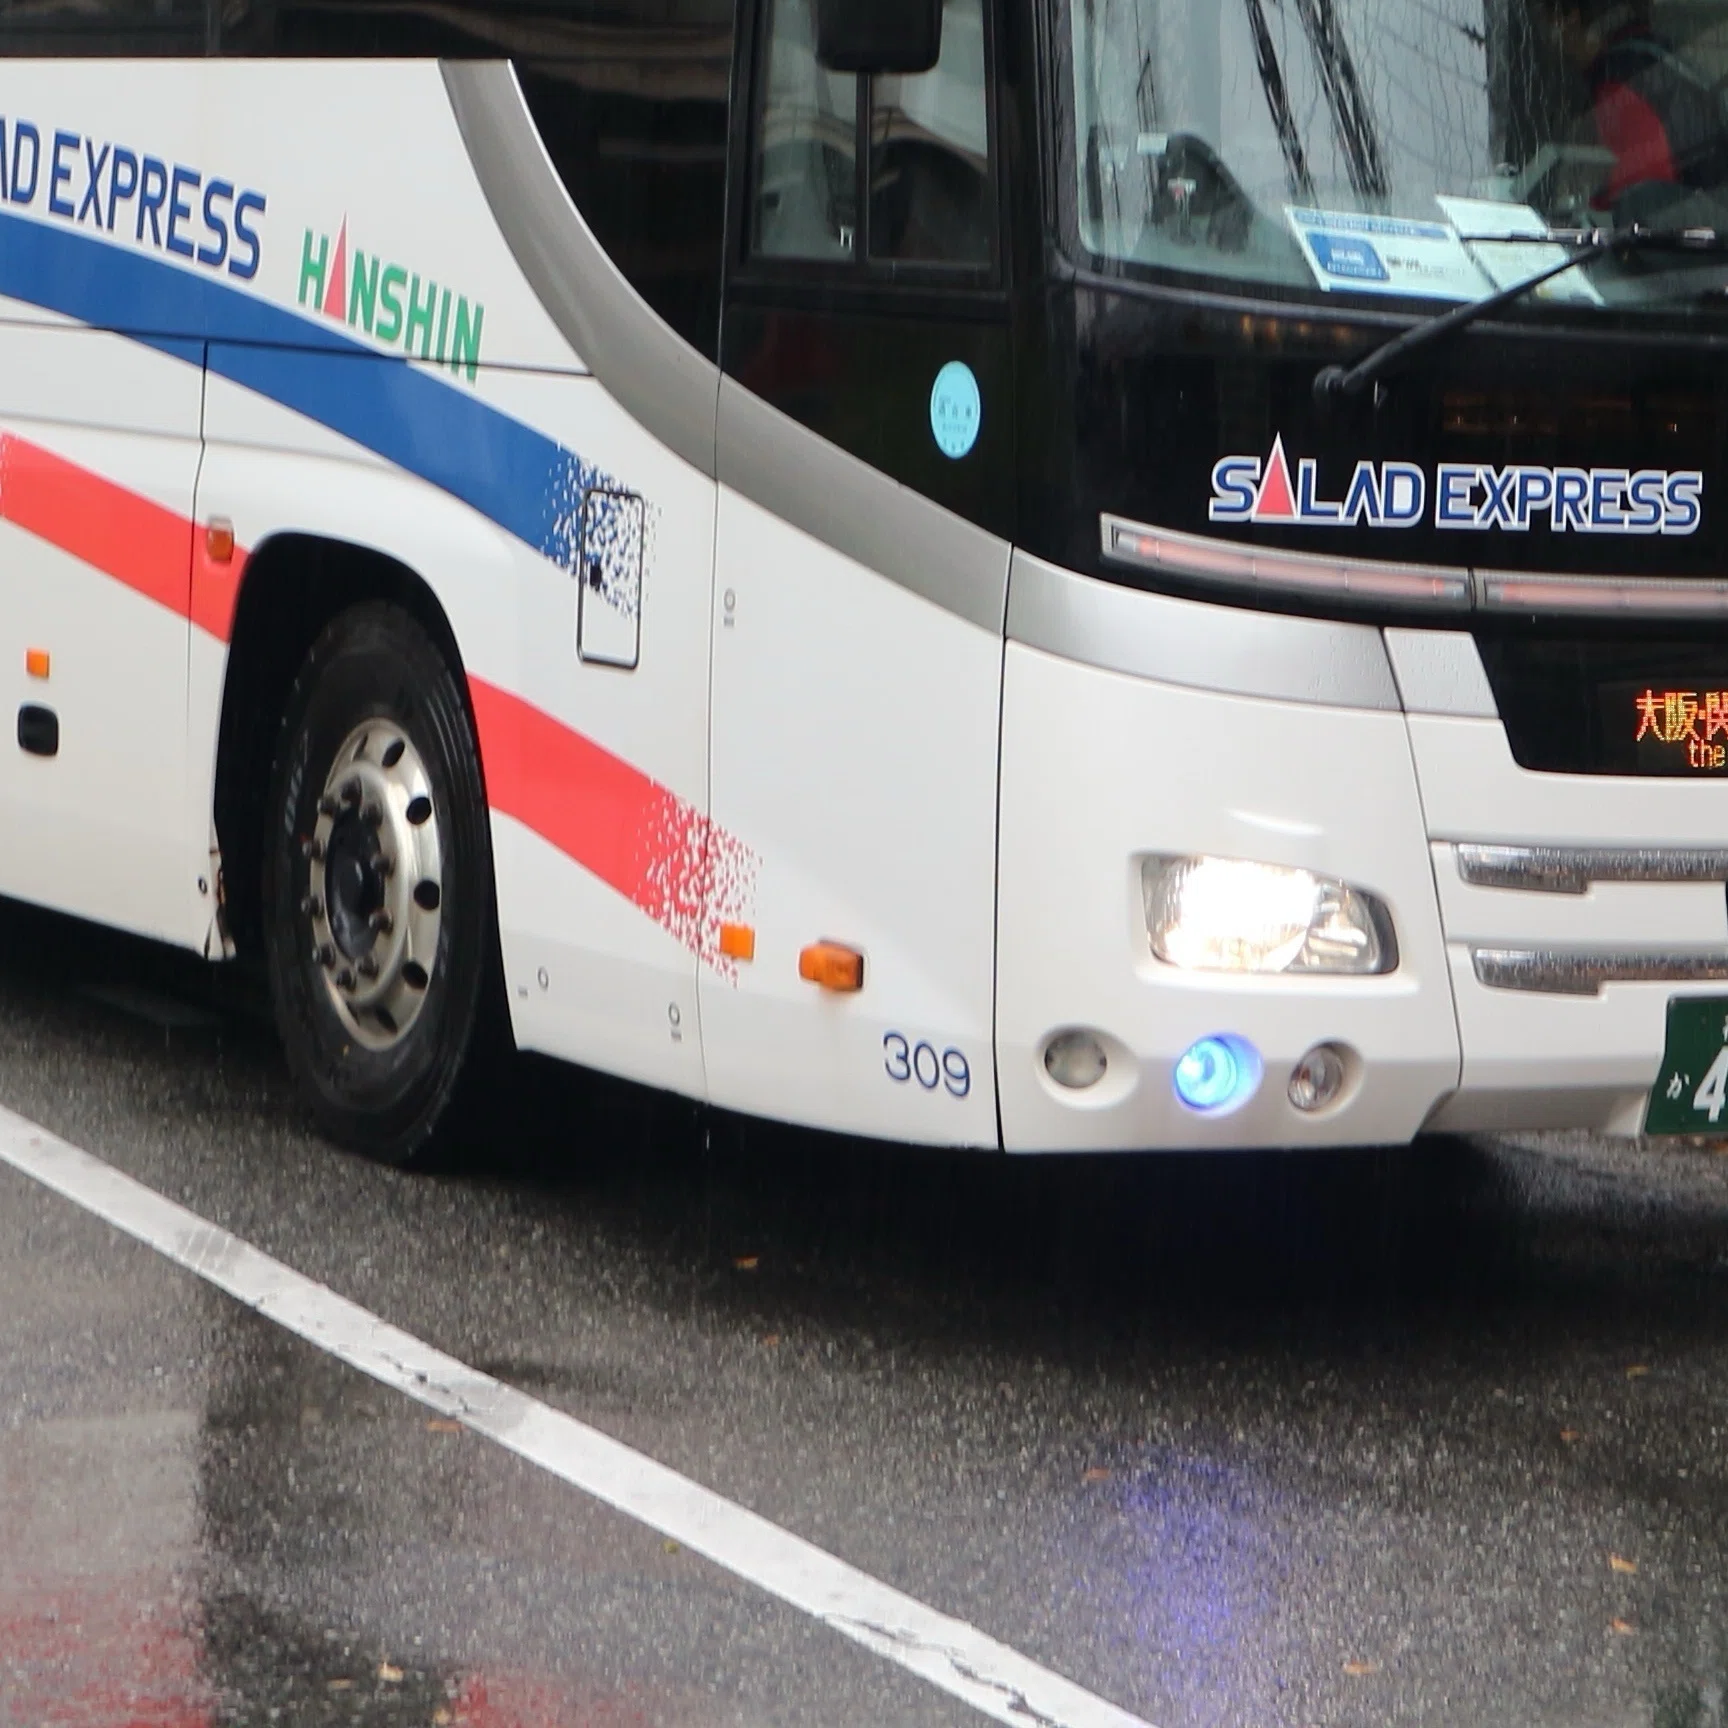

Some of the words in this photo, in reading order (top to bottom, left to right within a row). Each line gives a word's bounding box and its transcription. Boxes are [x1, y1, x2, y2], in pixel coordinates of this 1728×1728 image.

[49, 127, 267, 282] EXPRESS
[297, 211, 485, 383] HANSHIN
[1208, 431, 1426, 529] SALAD
[1434, 462, 1703, 536] EXPRESS
[1688, 737, 1726, 768] the
[883, 1029, 971, 1101] 309
[1666, 1071, 1691, 1100] か
